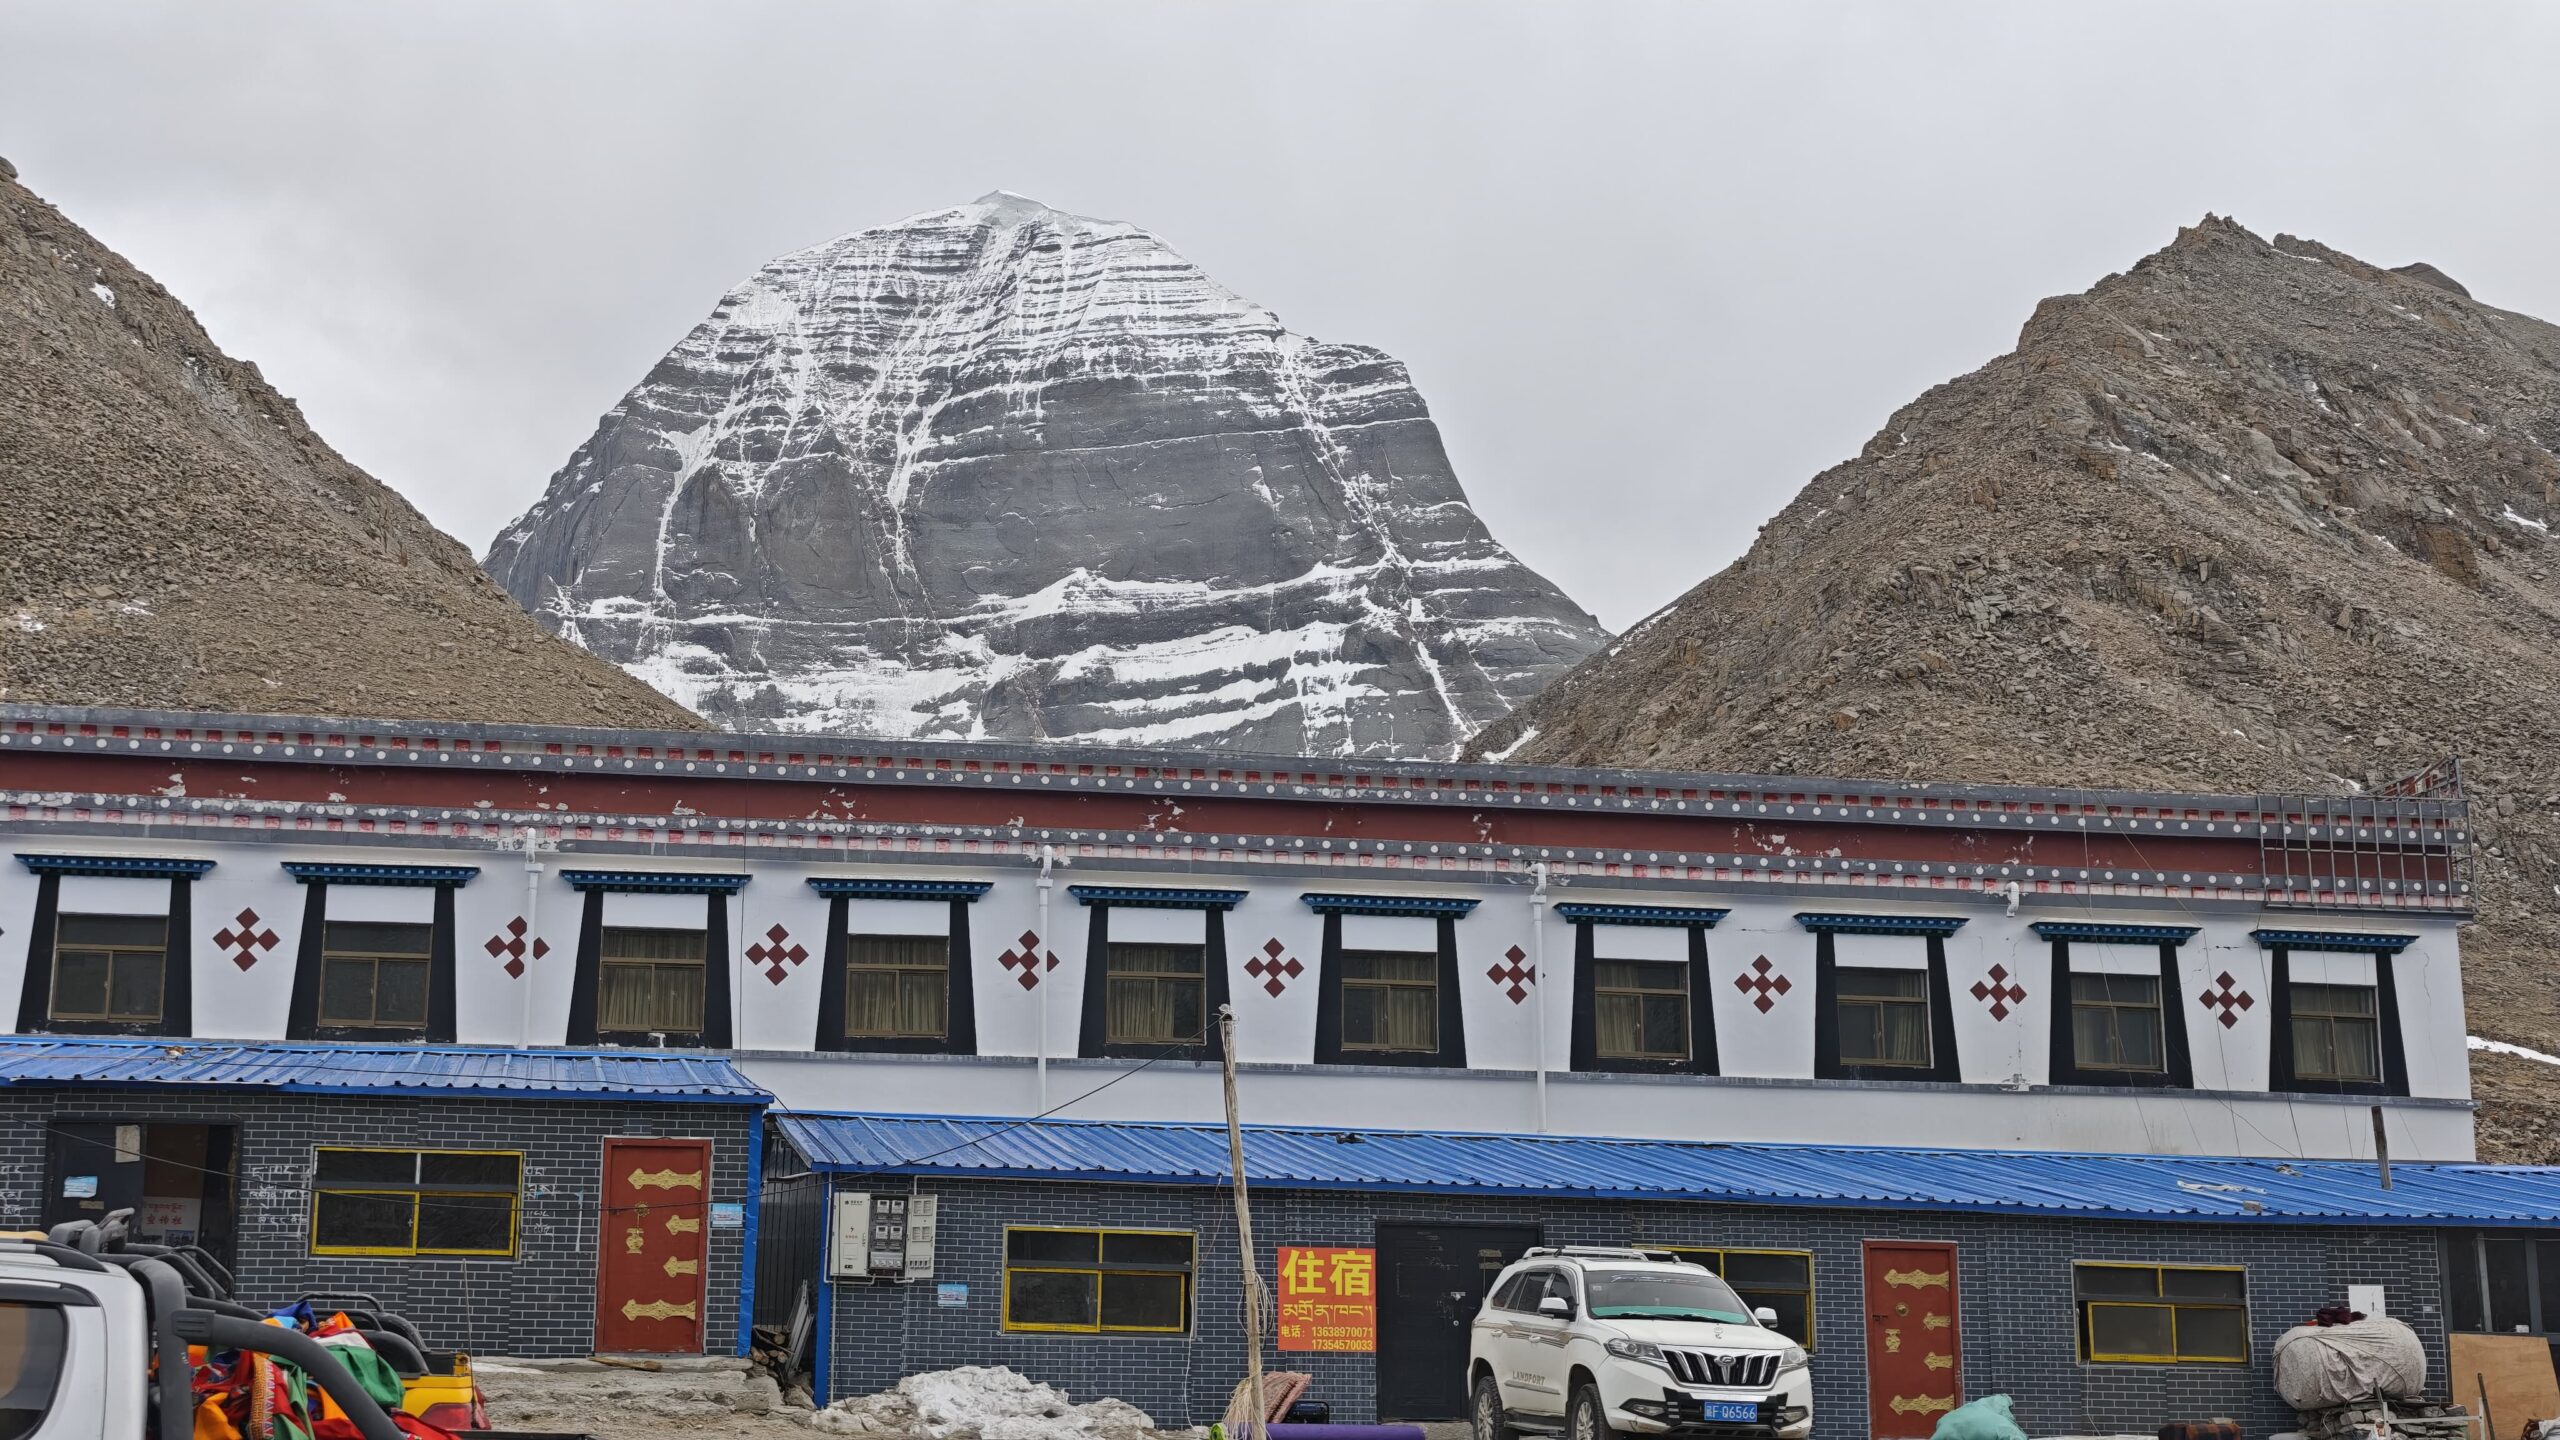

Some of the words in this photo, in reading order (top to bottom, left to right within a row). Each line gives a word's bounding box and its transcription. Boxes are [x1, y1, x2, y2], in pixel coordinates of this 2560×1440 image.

[1281, 1249, 1373, 1296] 住宿
[1312, 1326, 1373, 1338] 13638970071
[1312, 1339, 1373, 1350] 17354570033
